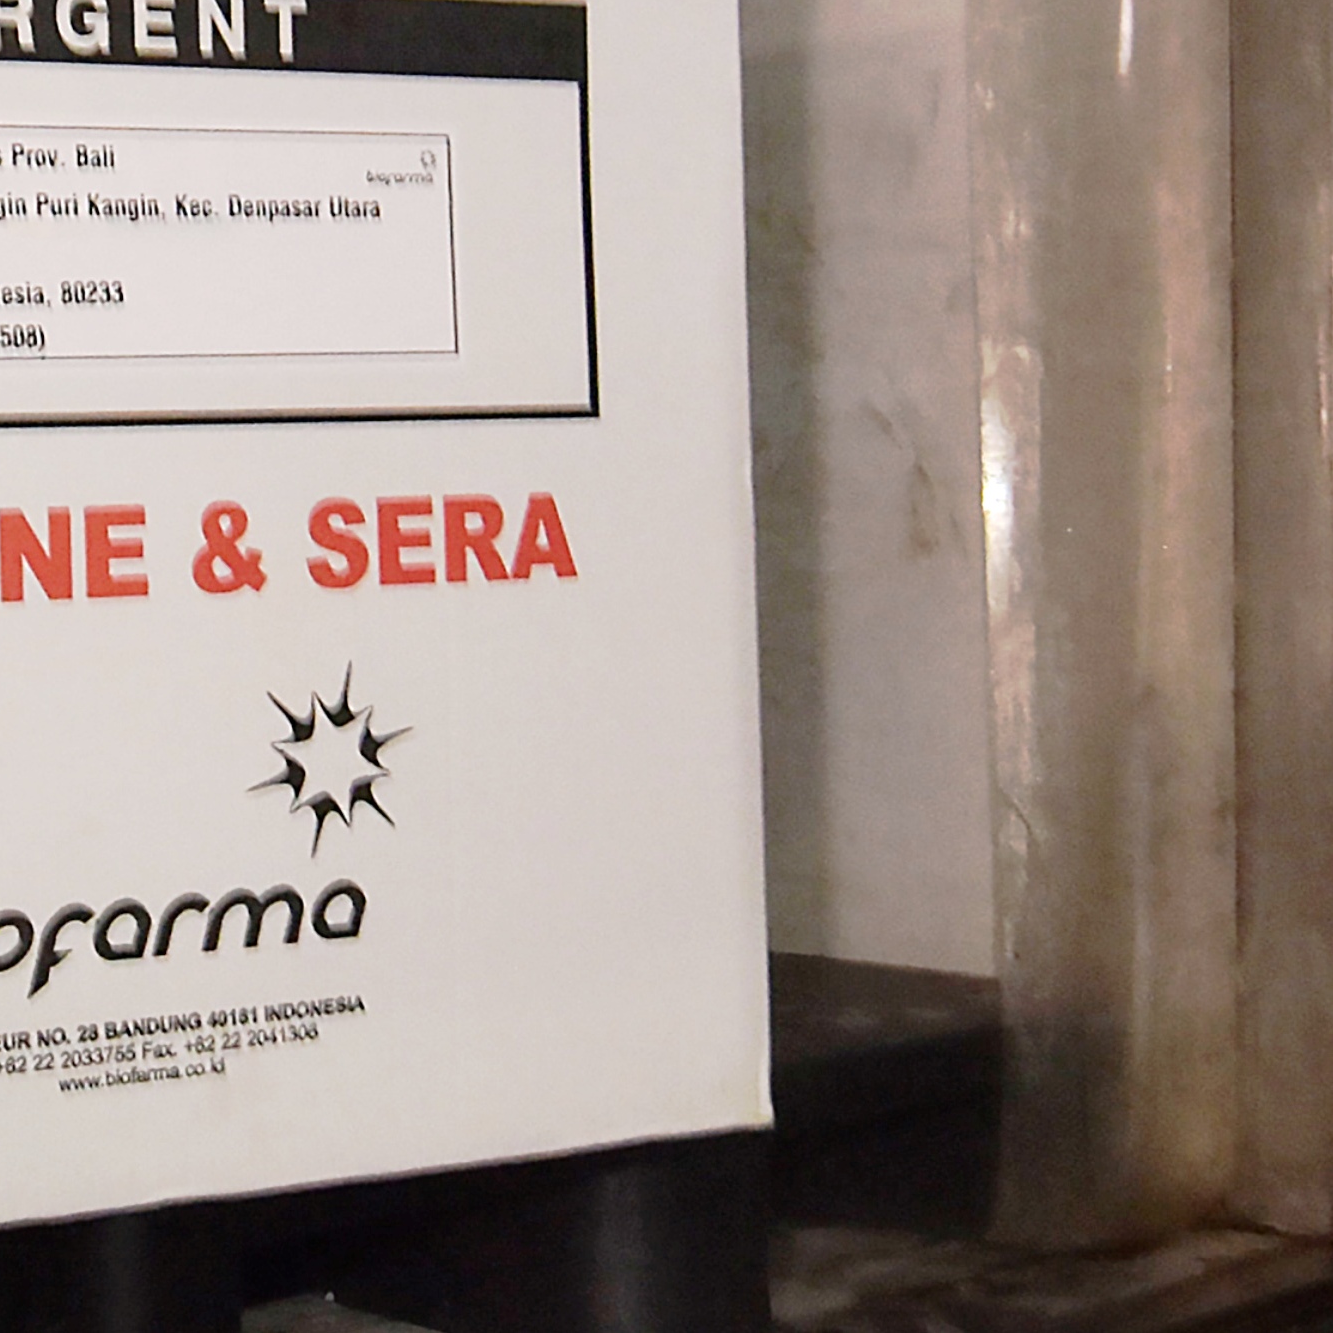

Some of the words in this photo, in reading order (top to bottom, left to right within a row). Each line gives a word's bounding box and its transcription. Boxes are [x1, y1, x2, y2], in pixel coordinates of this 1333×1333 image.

[12, 142, 67, 168] Prov.
[76, 144, 116, 169] Bali
[36, 192, 79, 217] Puri
[87, 193, 166, 222] Kangin,
[175, 194, 219, 218] Kec.
[228, 194, 321, 223] Denpasar
[329, 196, 382, 219] Utara
[60, 281, 126, 305] 80233
[190, 499, 267, 595] &
[305, 491, 578, 590] SERA
[37, 1027, 70, 1048] NO.
[104, 1012, 202, 1040] BANDUNG
[264, 995, 366, 1021] INDONESIA
[34, 1053, 55, 1071] 22
[221, 1033, 241, 1050] 22
